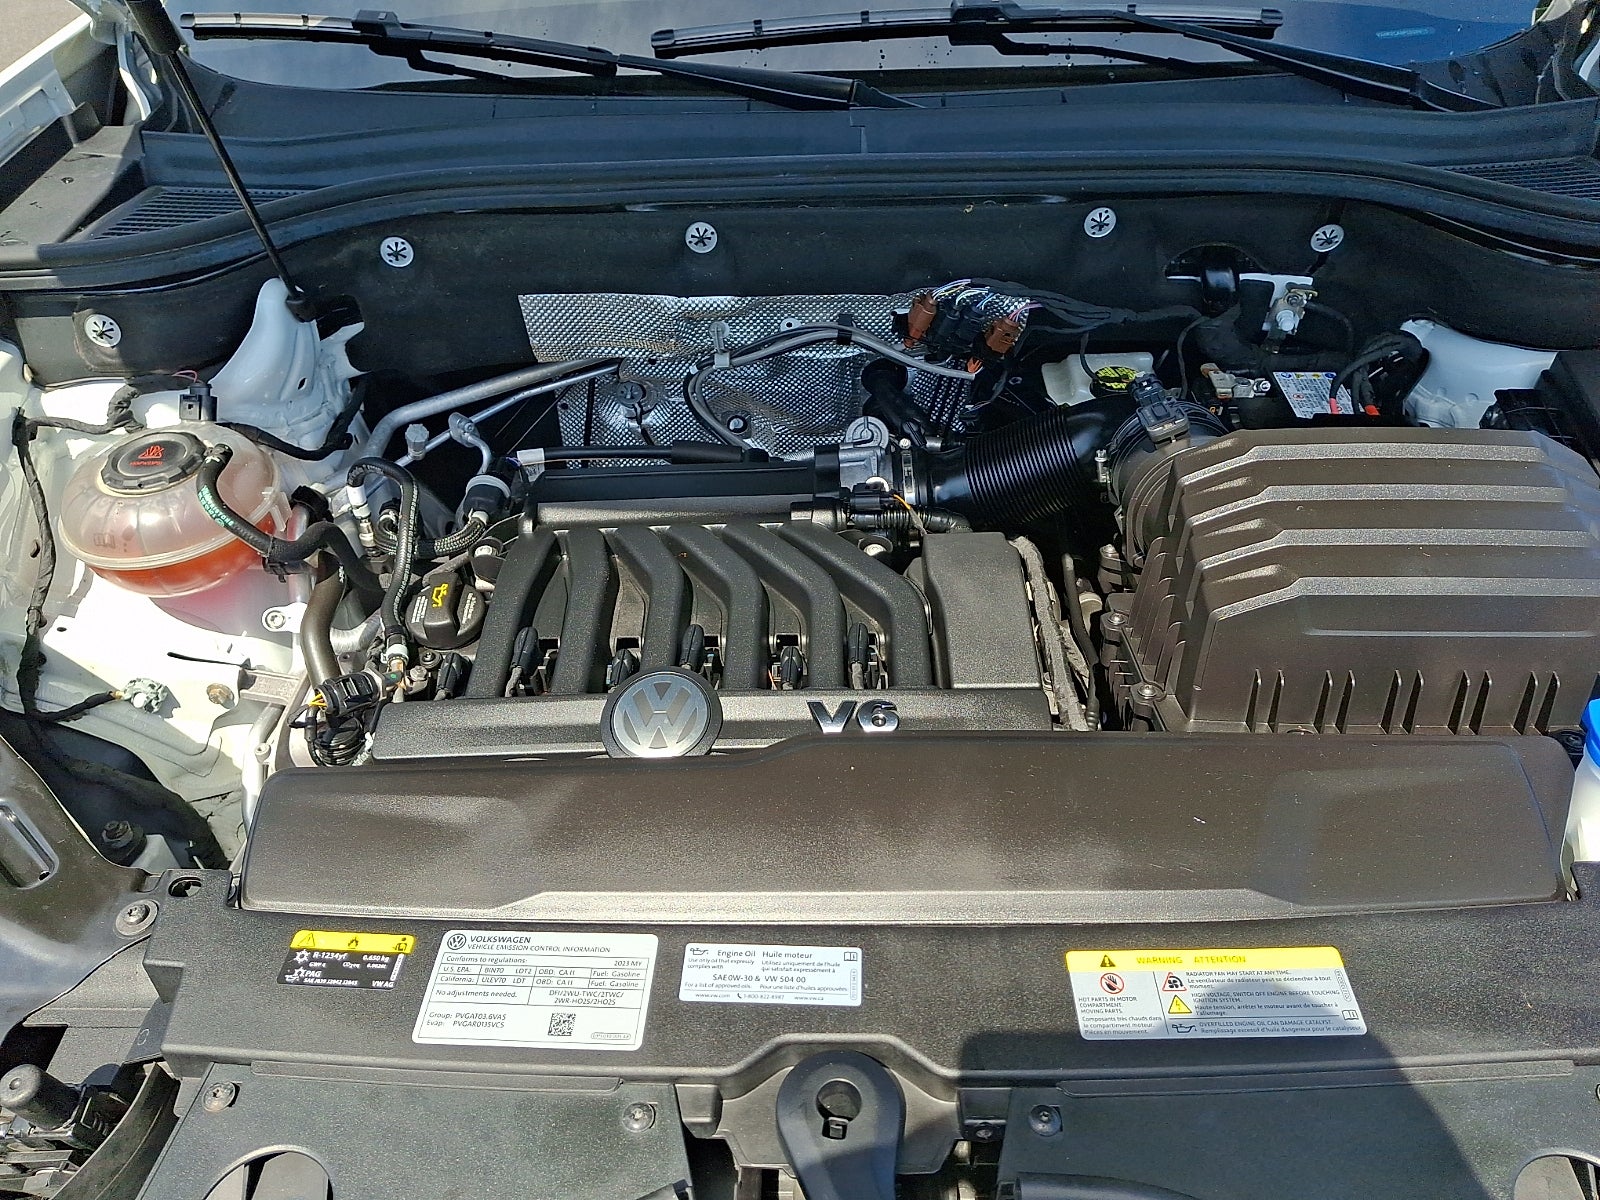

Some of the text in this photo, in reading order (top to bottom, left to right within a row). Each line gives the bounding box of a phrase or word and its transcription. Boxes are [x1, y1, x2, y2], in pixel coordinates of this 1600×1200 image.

[806, 699, 899, 734] V6
[470, 935, 531, 944] VOLKSWAGEN
[313, 952, 348, 960] R-1234yf
[717, 949, 744, 958] Engine
[1137, 955, 1246, 964] WARNING ATTENTION
[305, 970, 322, 978] PAG
[440, 975, 474, 983] California:
[536, 978, 554, 986] OBD:
[609, 980, 639, 988] Gasoline
[446, 989, 489, 998] adjustments
[490, 990, 517, 998] needed.
[428, 1011, 453, 1020] Group:
[426, 1019, 444, 1028] Evap:
